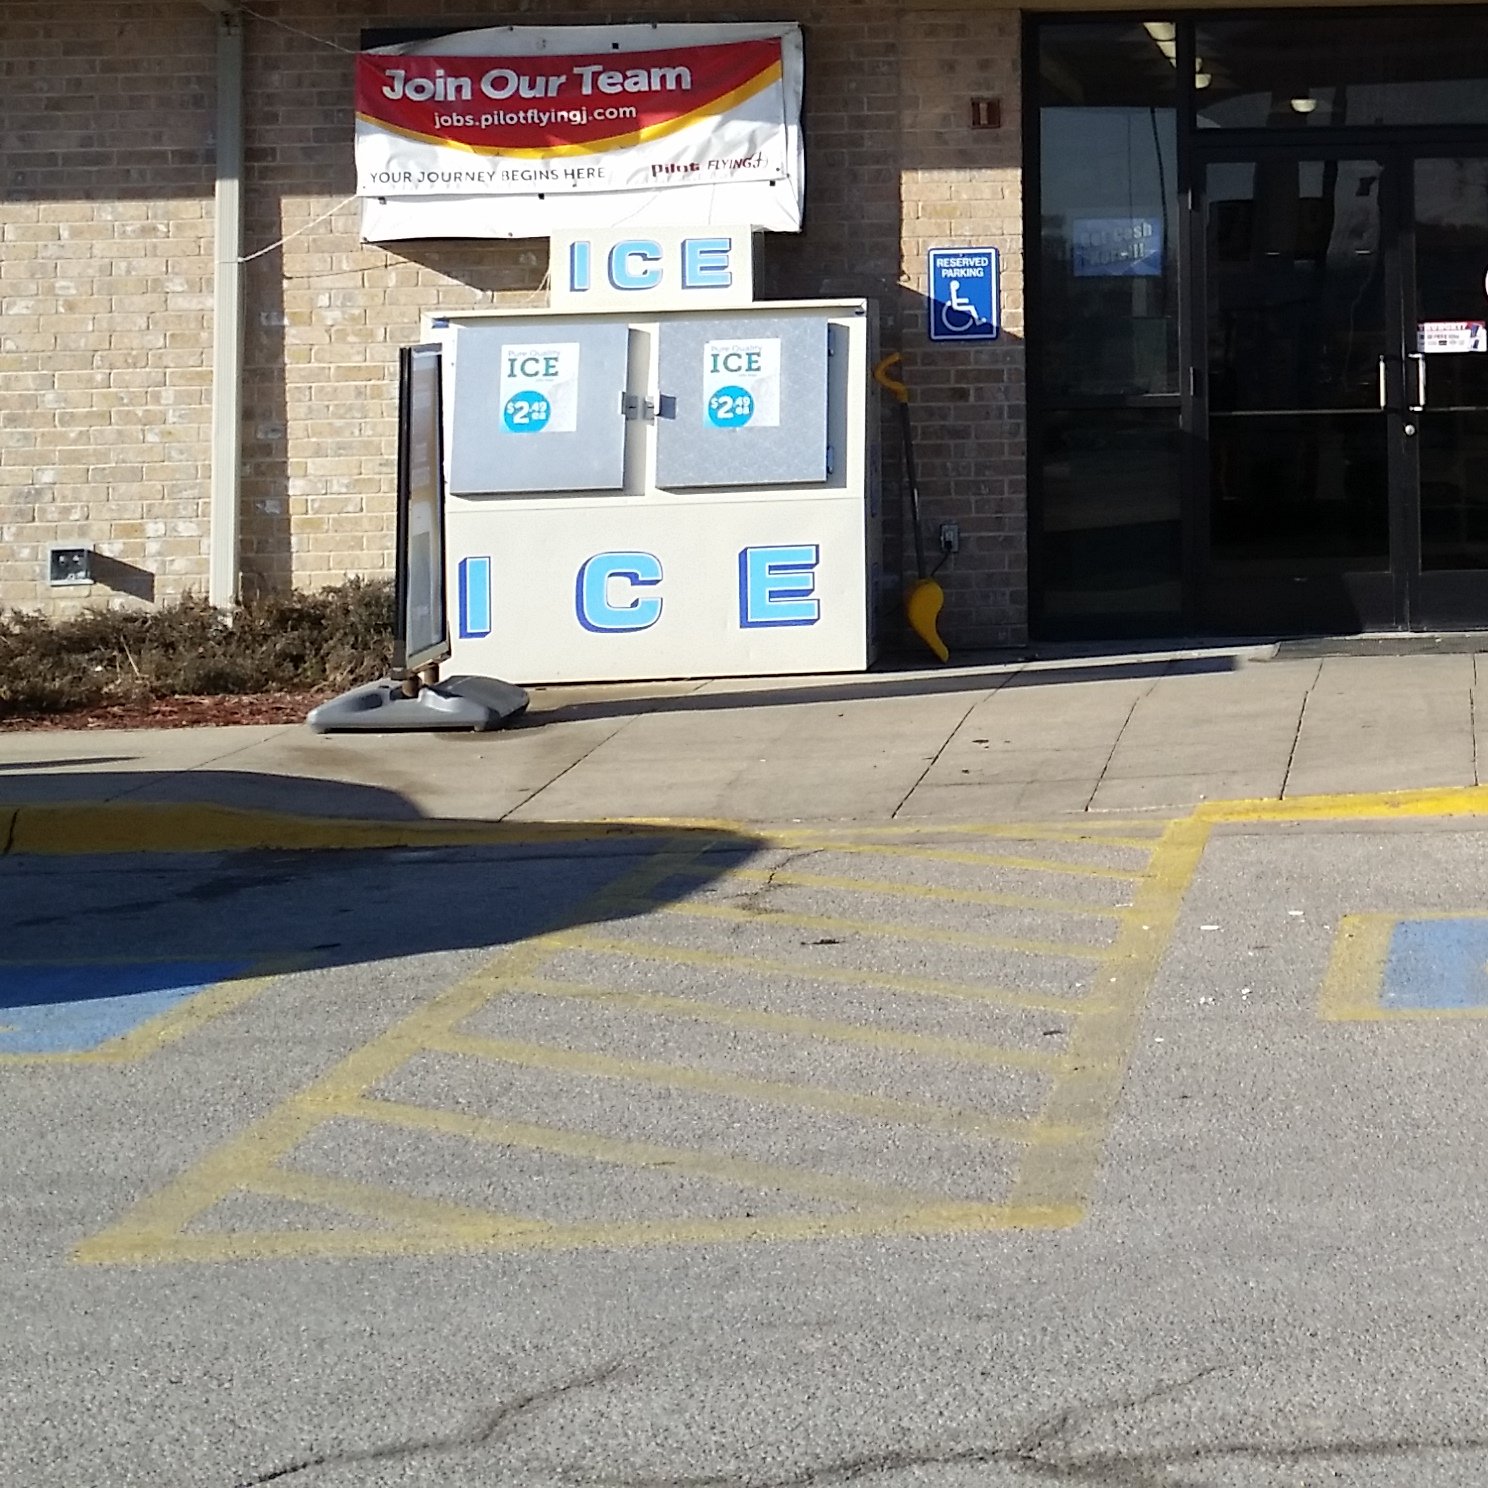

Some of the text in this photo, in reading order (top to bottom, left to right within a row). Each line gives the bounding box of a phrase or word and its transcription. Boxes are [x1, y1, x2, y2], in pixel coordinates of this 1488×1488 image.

[382, 65, 692, 102] Join Our Team
[434, 106, 637, 129] jobs.pilotflyingj.com
[370, 167, 605, 184] YOUR JOURNEY BEGINS HERE
[568, 237, 732, 292] ICE
[936, 257, 988, 268] RESERVED
[941, 267, 985, 278] PARKING
[507, 357, 559, 378] ICE
[710, 352, 761, 373] ICE
[458, 544, 820, 640] ICE
